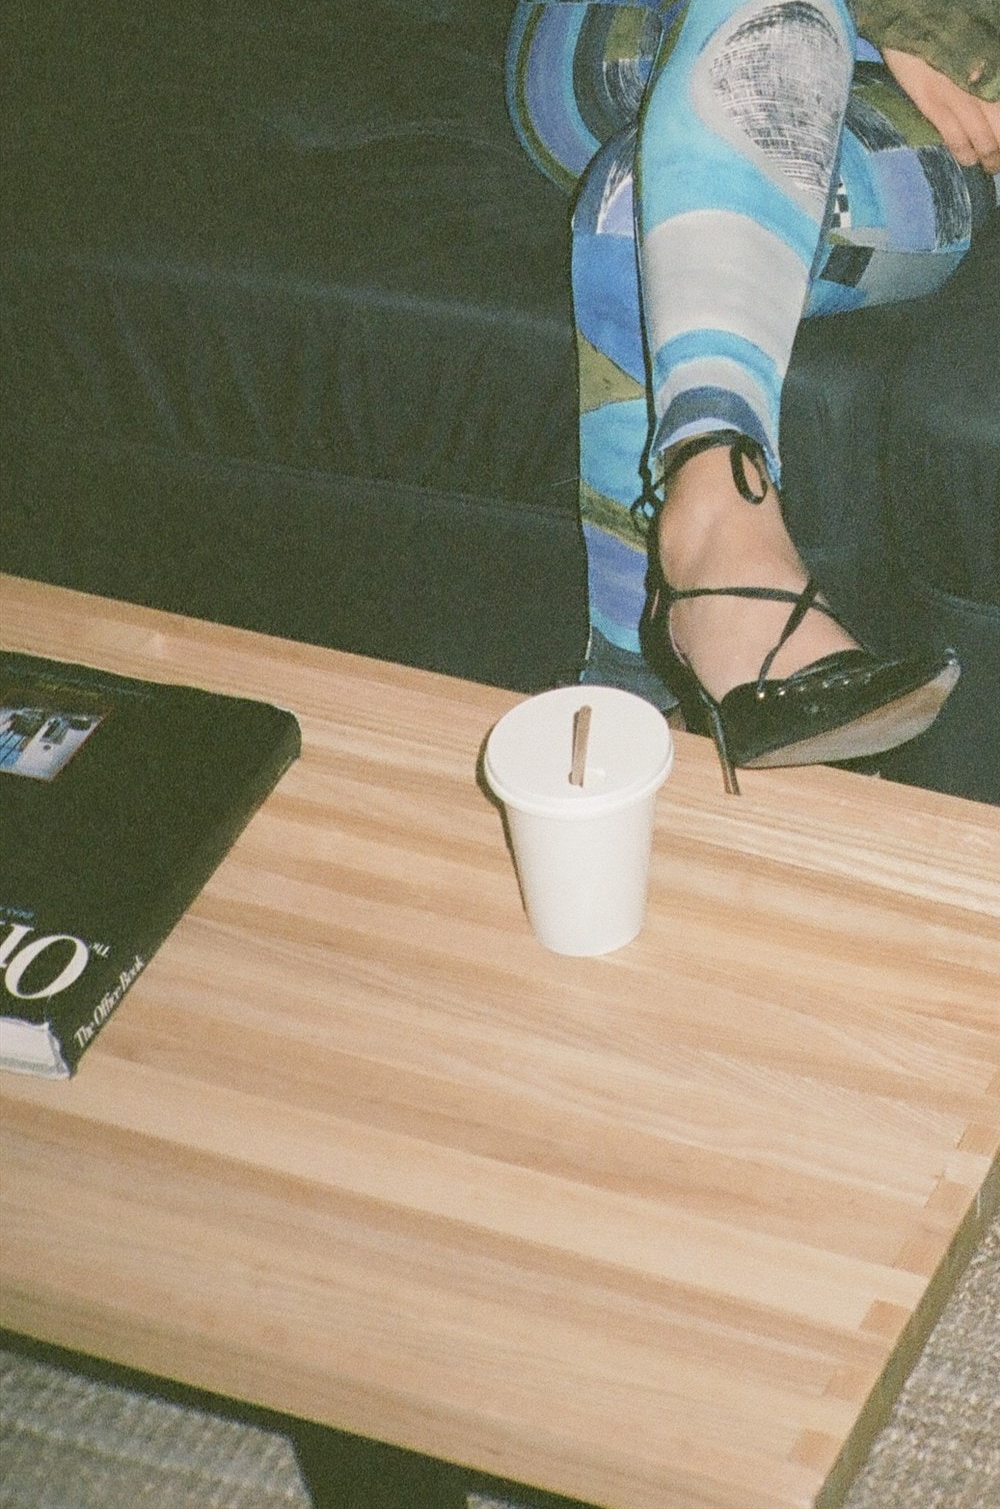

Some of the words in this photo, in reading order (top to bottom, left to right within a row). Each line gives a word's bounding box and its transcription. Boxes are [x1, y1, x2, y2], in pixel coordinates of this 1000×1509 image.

[74, 1023, 95, 1048] The
[93, 987, 121, 1026] Office
[119, 954, 145, 991] Book
